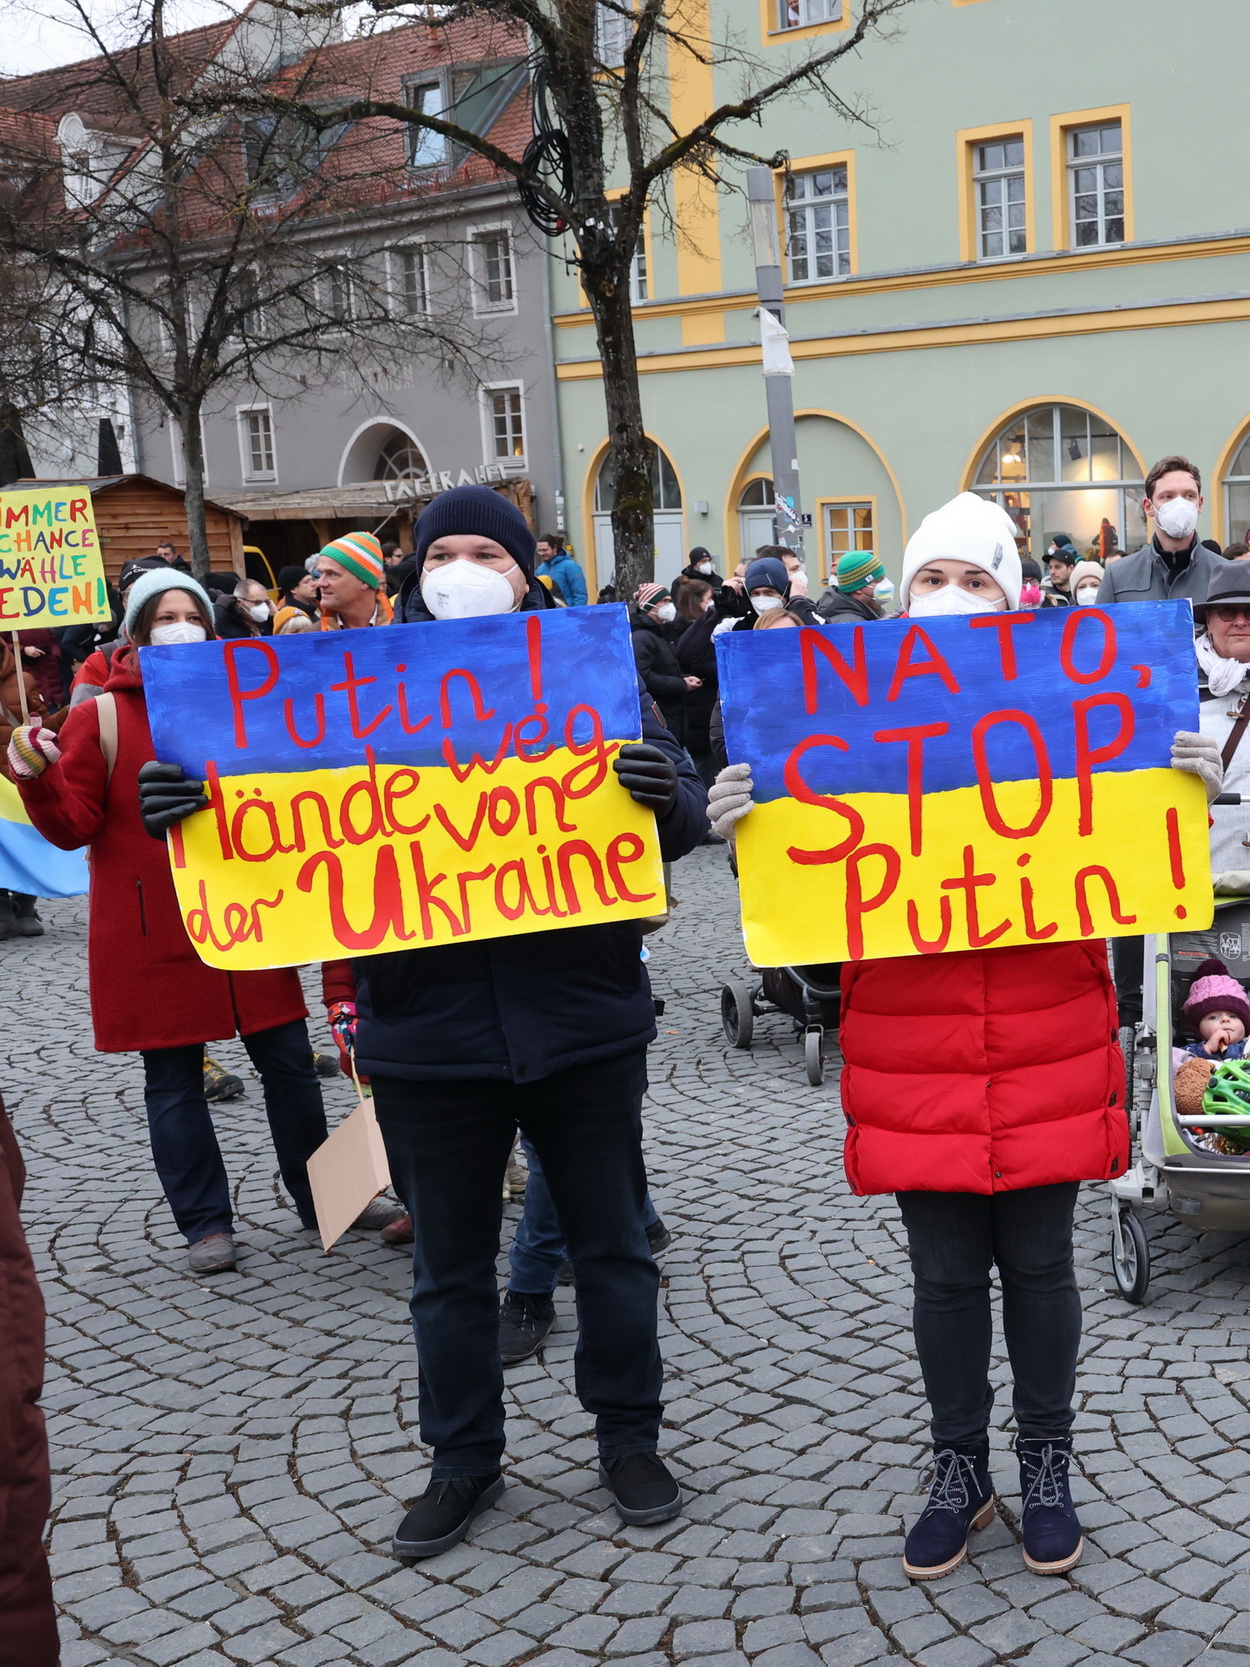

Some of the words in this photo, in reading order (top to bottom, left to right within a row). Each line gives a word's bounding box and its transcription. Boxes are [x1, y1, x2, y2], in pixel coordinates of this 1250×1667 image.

[0, 498, 89, 529] MMER
[0, 553, 88, 585] WÄHLE
[799, 608, 1151, 714] NATO,
[442, 704, 620, 800] weg
[783, 692, 1136, 865] STOP
[172, 745, 431, 868] Hände
[435, 776, 577, 852] von
[187, 880, 283, 951] der
[297, 833, 656, 950] Ukraine
